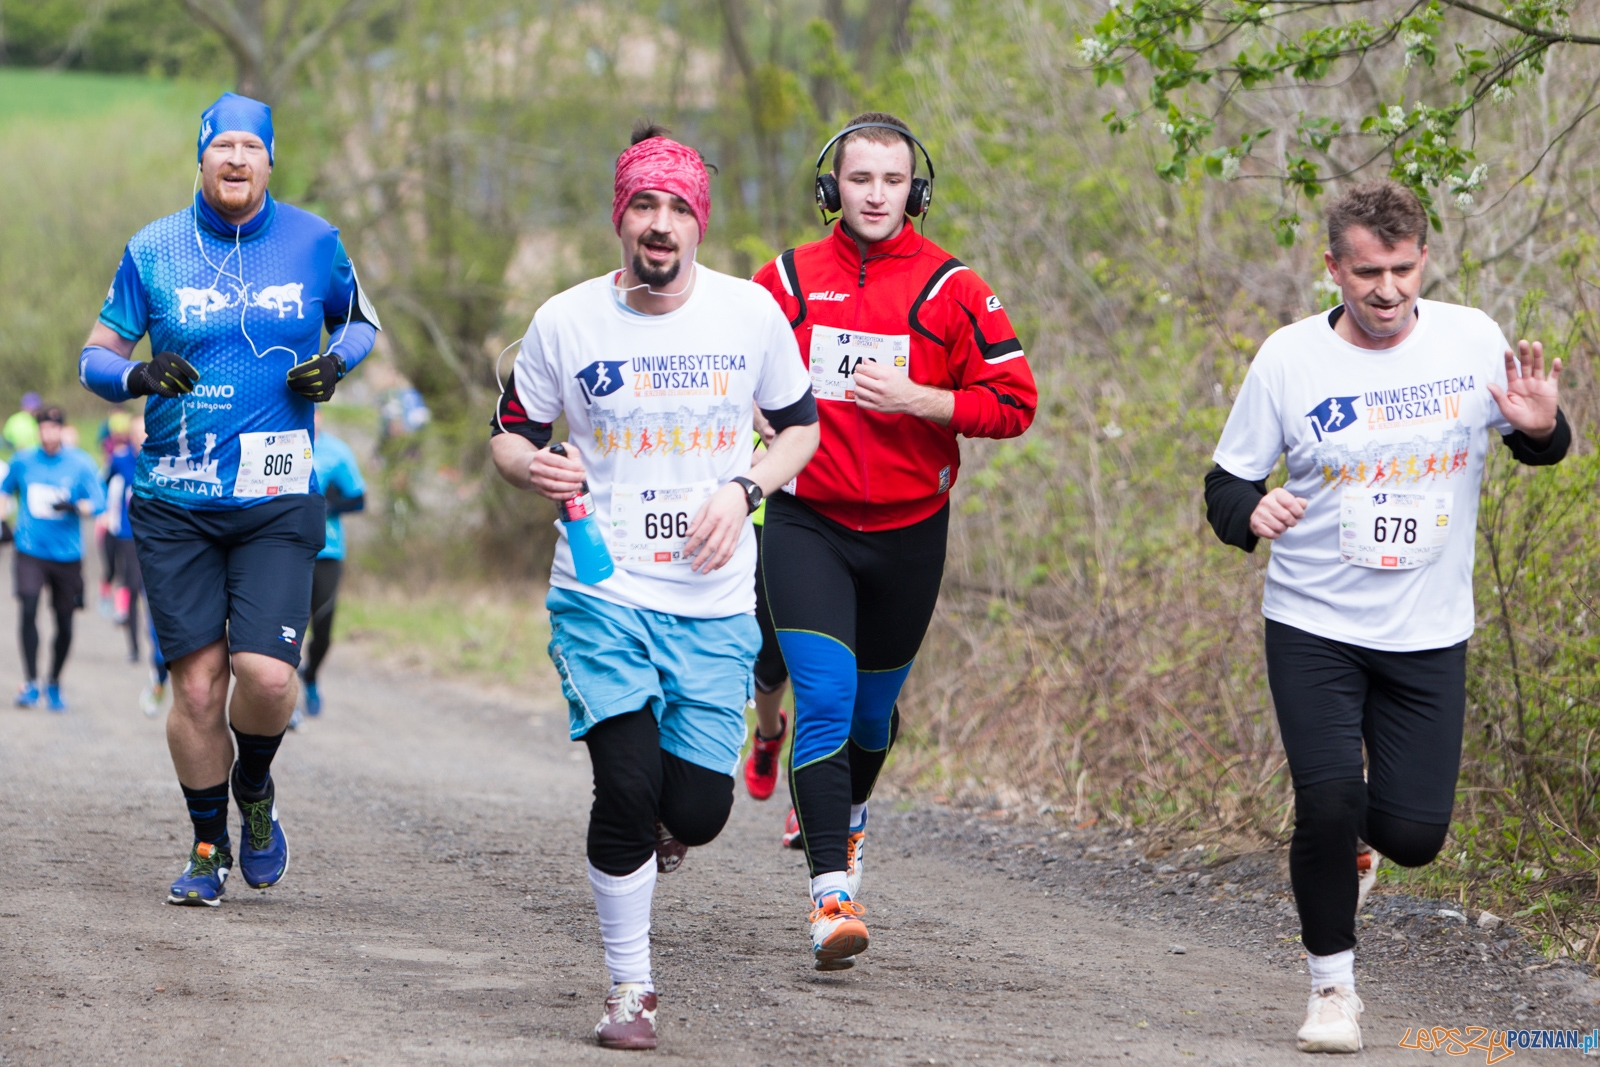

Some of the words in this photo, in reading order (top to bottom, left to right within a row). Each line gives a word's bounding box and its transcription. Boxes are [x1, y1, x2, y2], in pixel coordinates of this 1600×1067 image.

[807, 290, 850, 302] saller
[632, 355, 746, 372] UNIWERSYTECKA
[837, 354, 877, 379] 44
[634, 371, 709, 390] ZADYSZKA
[713, 371, 729, 396] IV
[1364, 375, 1475, 407] UNIWERSYTECKA
[186, 401, 195, 409] na
[196, 400, 233, 413] biegowo
[1366, 398, 1441, 424] ZADYSZKA
[1444, 394, 1461, 420] IV
[264, 453, 293, 476] 806
[645, 511, 688, 540] 696
[1374, 516, 1417, 544] 678
